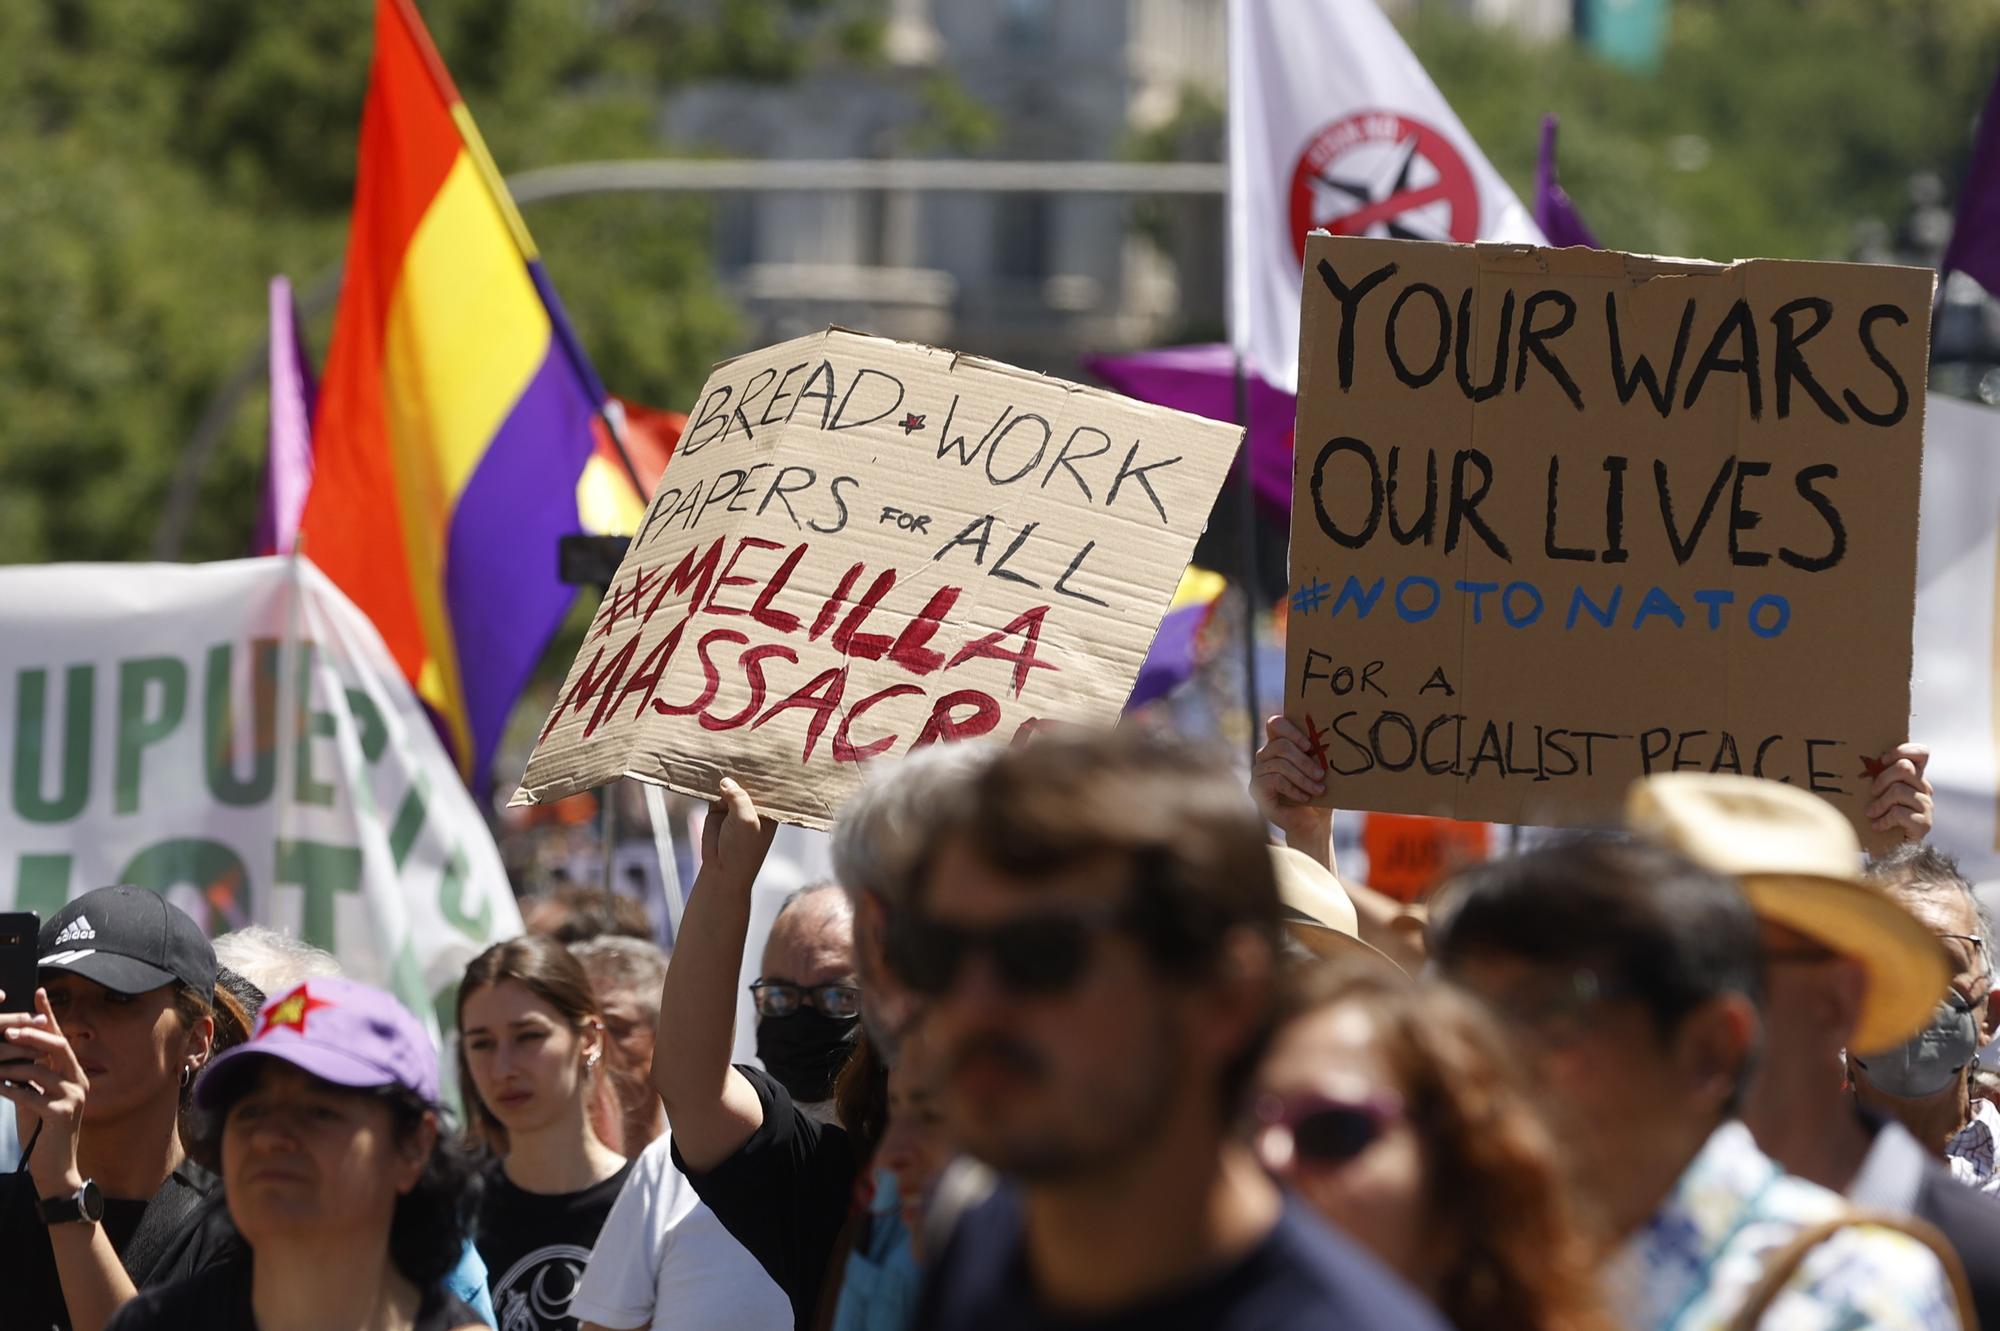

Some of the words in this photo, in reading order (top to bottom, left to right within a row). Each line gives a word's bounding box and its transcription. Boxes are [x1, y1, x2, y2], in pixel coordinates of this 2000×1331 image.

[1315, 258, 1586, 411] YOUR
[1604, 290, 1910, 427] WARS
[682, 360, 905, 457] BREAD
[935, 393, 1184, 525] WORK
[1309, 435, 1514, 564] OUR
[1545, 454, 1848, 573] LIVES
[636, 462, 862, 550] PAPERS
[879, 505, 932, 537] FOR
[932, 514, 1110, 608] ALL
[594, 536, 1061, 699] #MELILLA
[1300, 648, 1388, 699] FOR
[1418, 664, 1457, 697] A
[1329, 710, 1633, 783] SOCIALIST
[1640, 726, 1853, 796] PEACE
[54, 929, 97, 947] adidas
